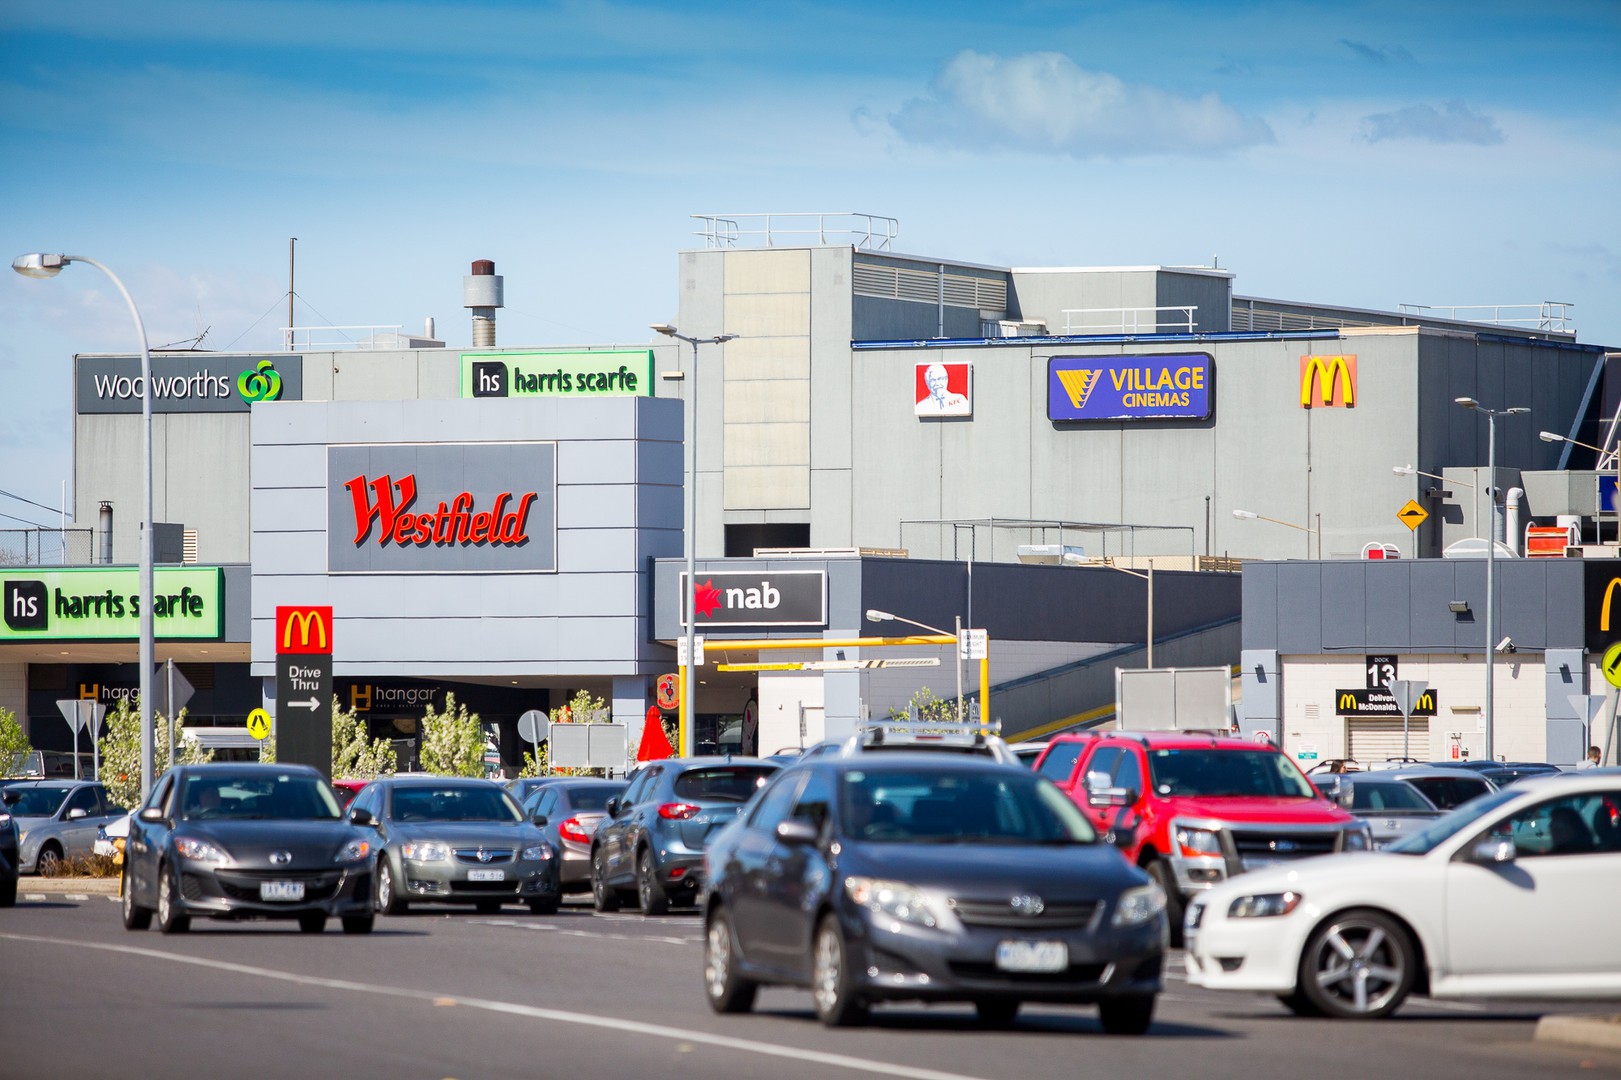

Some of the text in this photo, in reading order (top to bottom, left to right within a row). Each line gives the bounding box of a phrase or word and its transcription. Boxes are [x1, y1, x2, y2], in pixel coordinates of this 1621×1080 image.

[480, 365, 637, 392] hs harris scarfe
[1109, 367, 1204, 390] VILLAGE
[1122, 392, 1190, 407] CINEMAS
[343, 474, 538, 546] Westfield
[13, 587, 204, 618] hs harris sarfe
[726, 581, 781, 609] nab
[289, 666, 321, 678] Drive
[1368, 664, 1396, 687] 13
[290, 678, 319, 690] Thru
[375, 686, 437, 704] hangar
[1358, 703, 1397, 711] McDonalds
